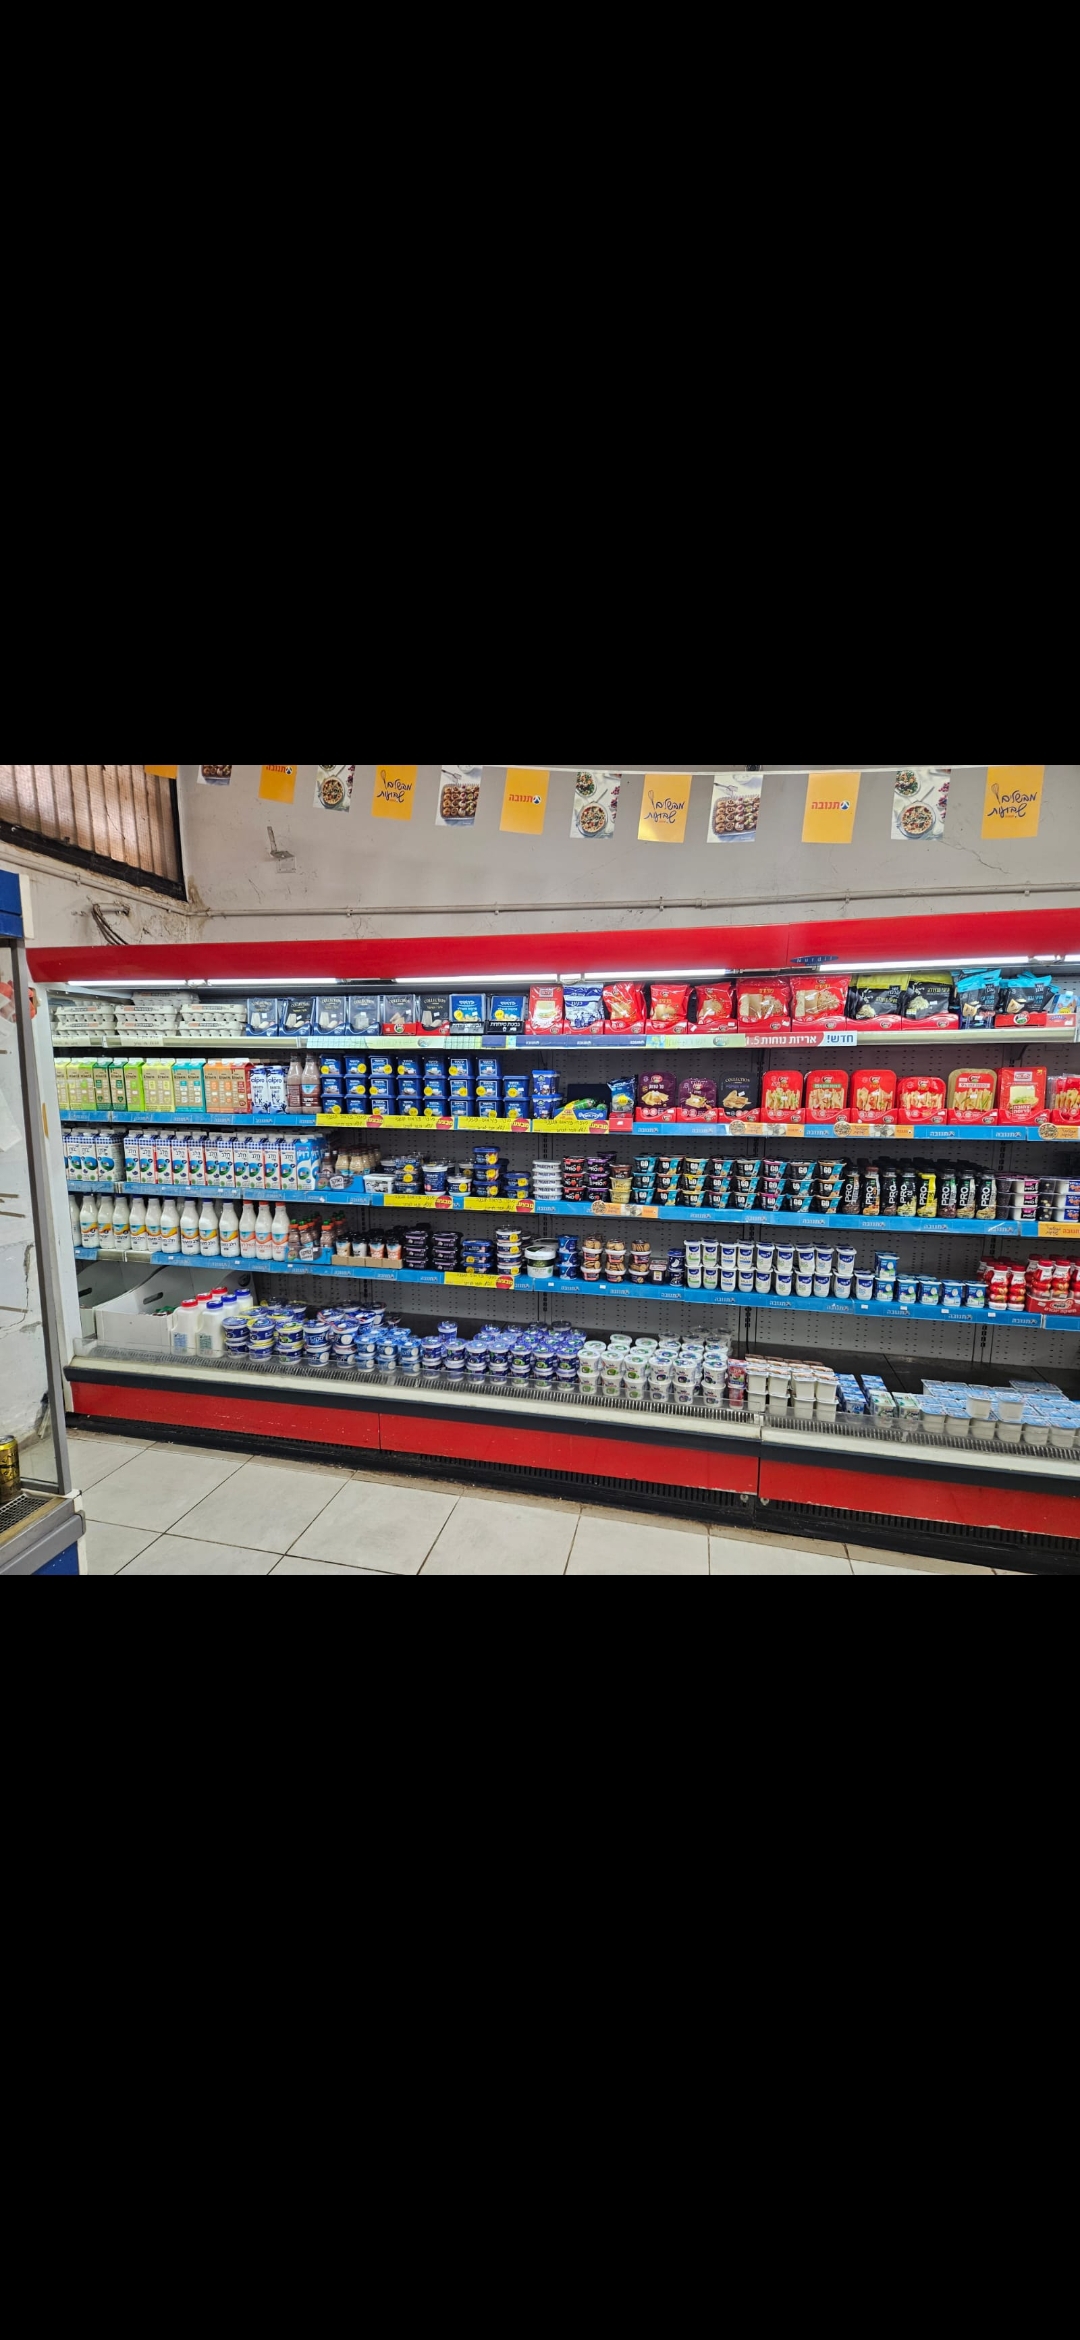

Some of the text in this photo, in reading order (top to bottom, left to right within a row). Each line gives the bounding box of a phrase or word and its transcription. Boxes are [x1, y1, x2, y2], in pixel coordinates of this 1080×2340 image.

[508, 794, 533, 803] תנובה
[811, 800, 840, 810] תנובה
[1001, 789, 1038, 803] מבשלים
[987, 803, 1028, 819] שבועות
[760, 1036, 785, 1045] נוחות
[789, 1035, 817, 1044] אריזת
[827, 1034, 854, 1043] חדש!
[845, 1183, 853, 1203] PRO
[866, 1186, 875, 1205] PRO
[889, 1184, 897, 1204] PRO
[900, 1184, 908, 1203] PRO
[919, 1185, 928, 1206] PRO
[941, 1186, 950, 1206] PRO
[960, 1186, 969, 1207] PRO
[981, 1186, 990, 1207] PRO
